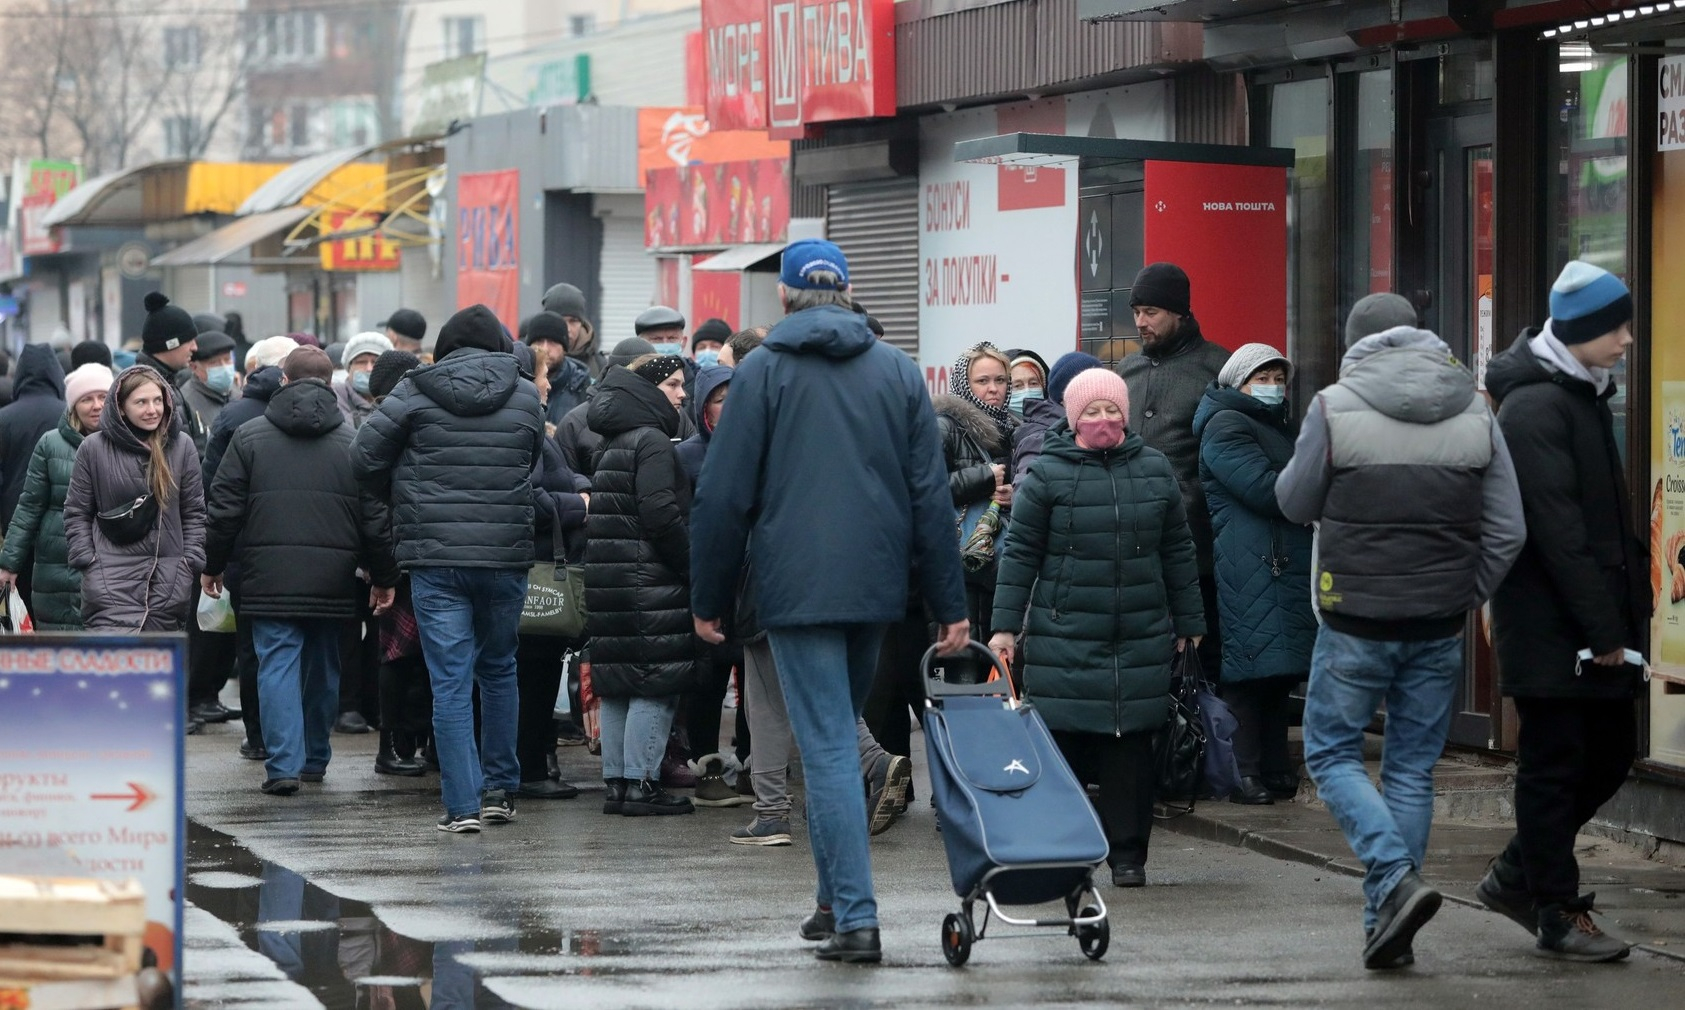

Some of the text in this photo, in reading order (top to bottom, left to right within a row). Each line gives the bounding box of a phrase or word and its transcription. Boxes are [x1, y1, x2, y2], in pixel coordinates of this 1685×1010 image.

[710, 22, 762, 97] МОРЕ
[803, 0, 870, 87] ПИВА
[1660, 62, 1685, 99] СМ
[926, 180, 970, 232] БОНУСИ
[1202, 202, 1275, 211] НОВА ПОШТА
[460, 205, 516, 268] РИБА
[926, 257, 940, 307] ЗА
[926, 365, 952, 395] ПО
[524, 596, 564, 606] NFAOIR
[59, 650, 172, 674] СЛАДОСТИ
[108, 826, 169, 851] Мира
